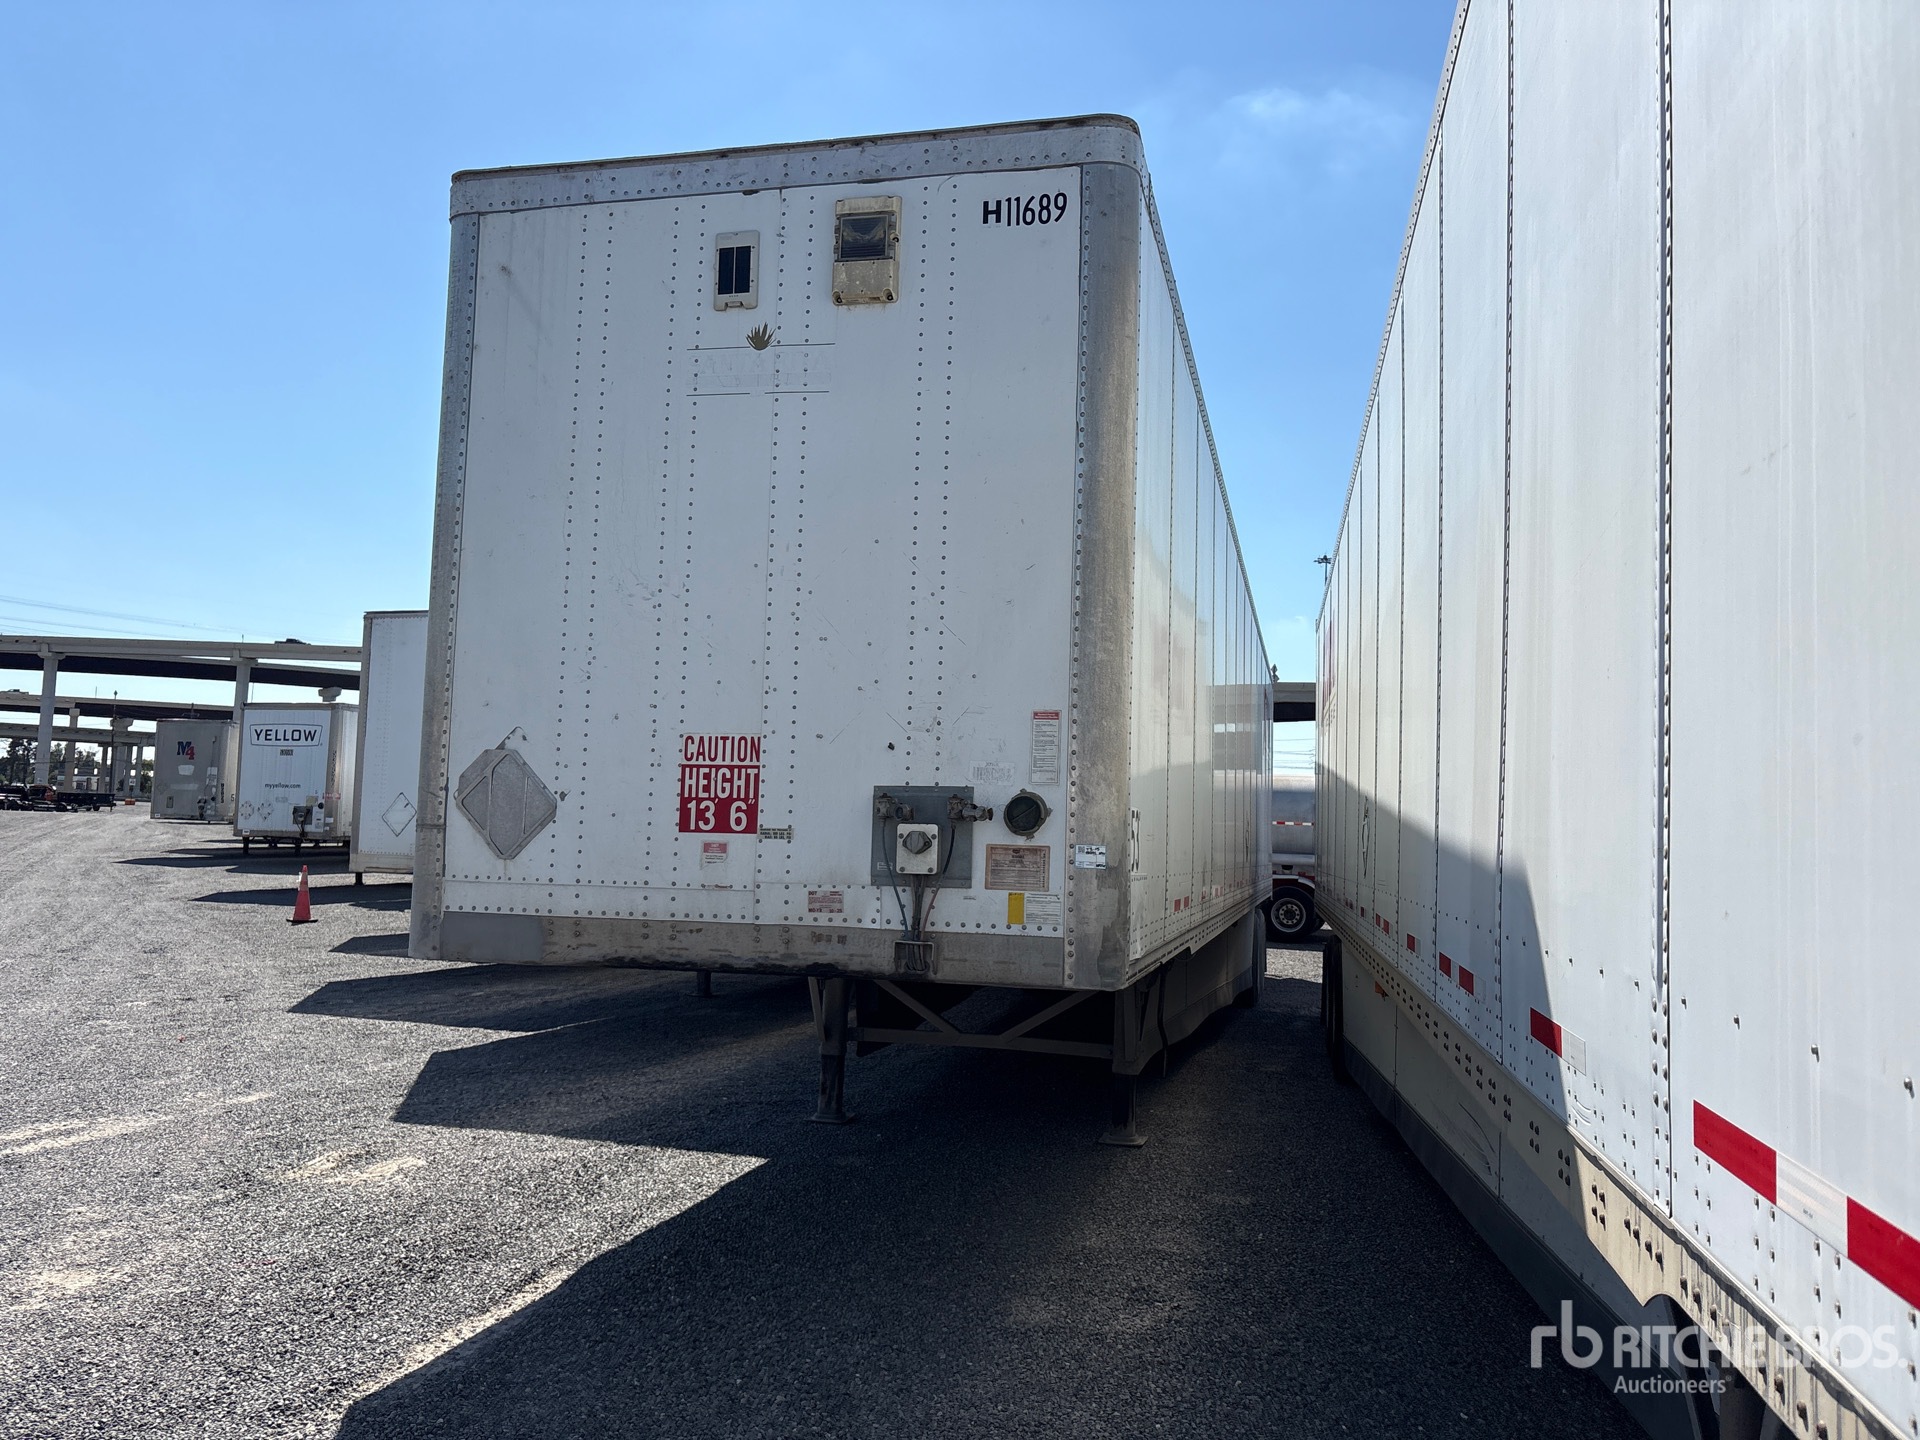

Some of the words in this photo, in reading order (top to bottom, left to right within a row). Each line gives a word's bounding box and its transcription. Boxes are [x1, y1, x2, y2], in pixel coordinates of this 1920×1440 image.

[982, 192, 1068, 227] H11689
[254, 728, 318, 742] YELLOW
[684, 735, 761, 763] CAUTION
[264, 782, 301, 790] myyellow.com
[684, 767, 758, 799] HEIGHT
